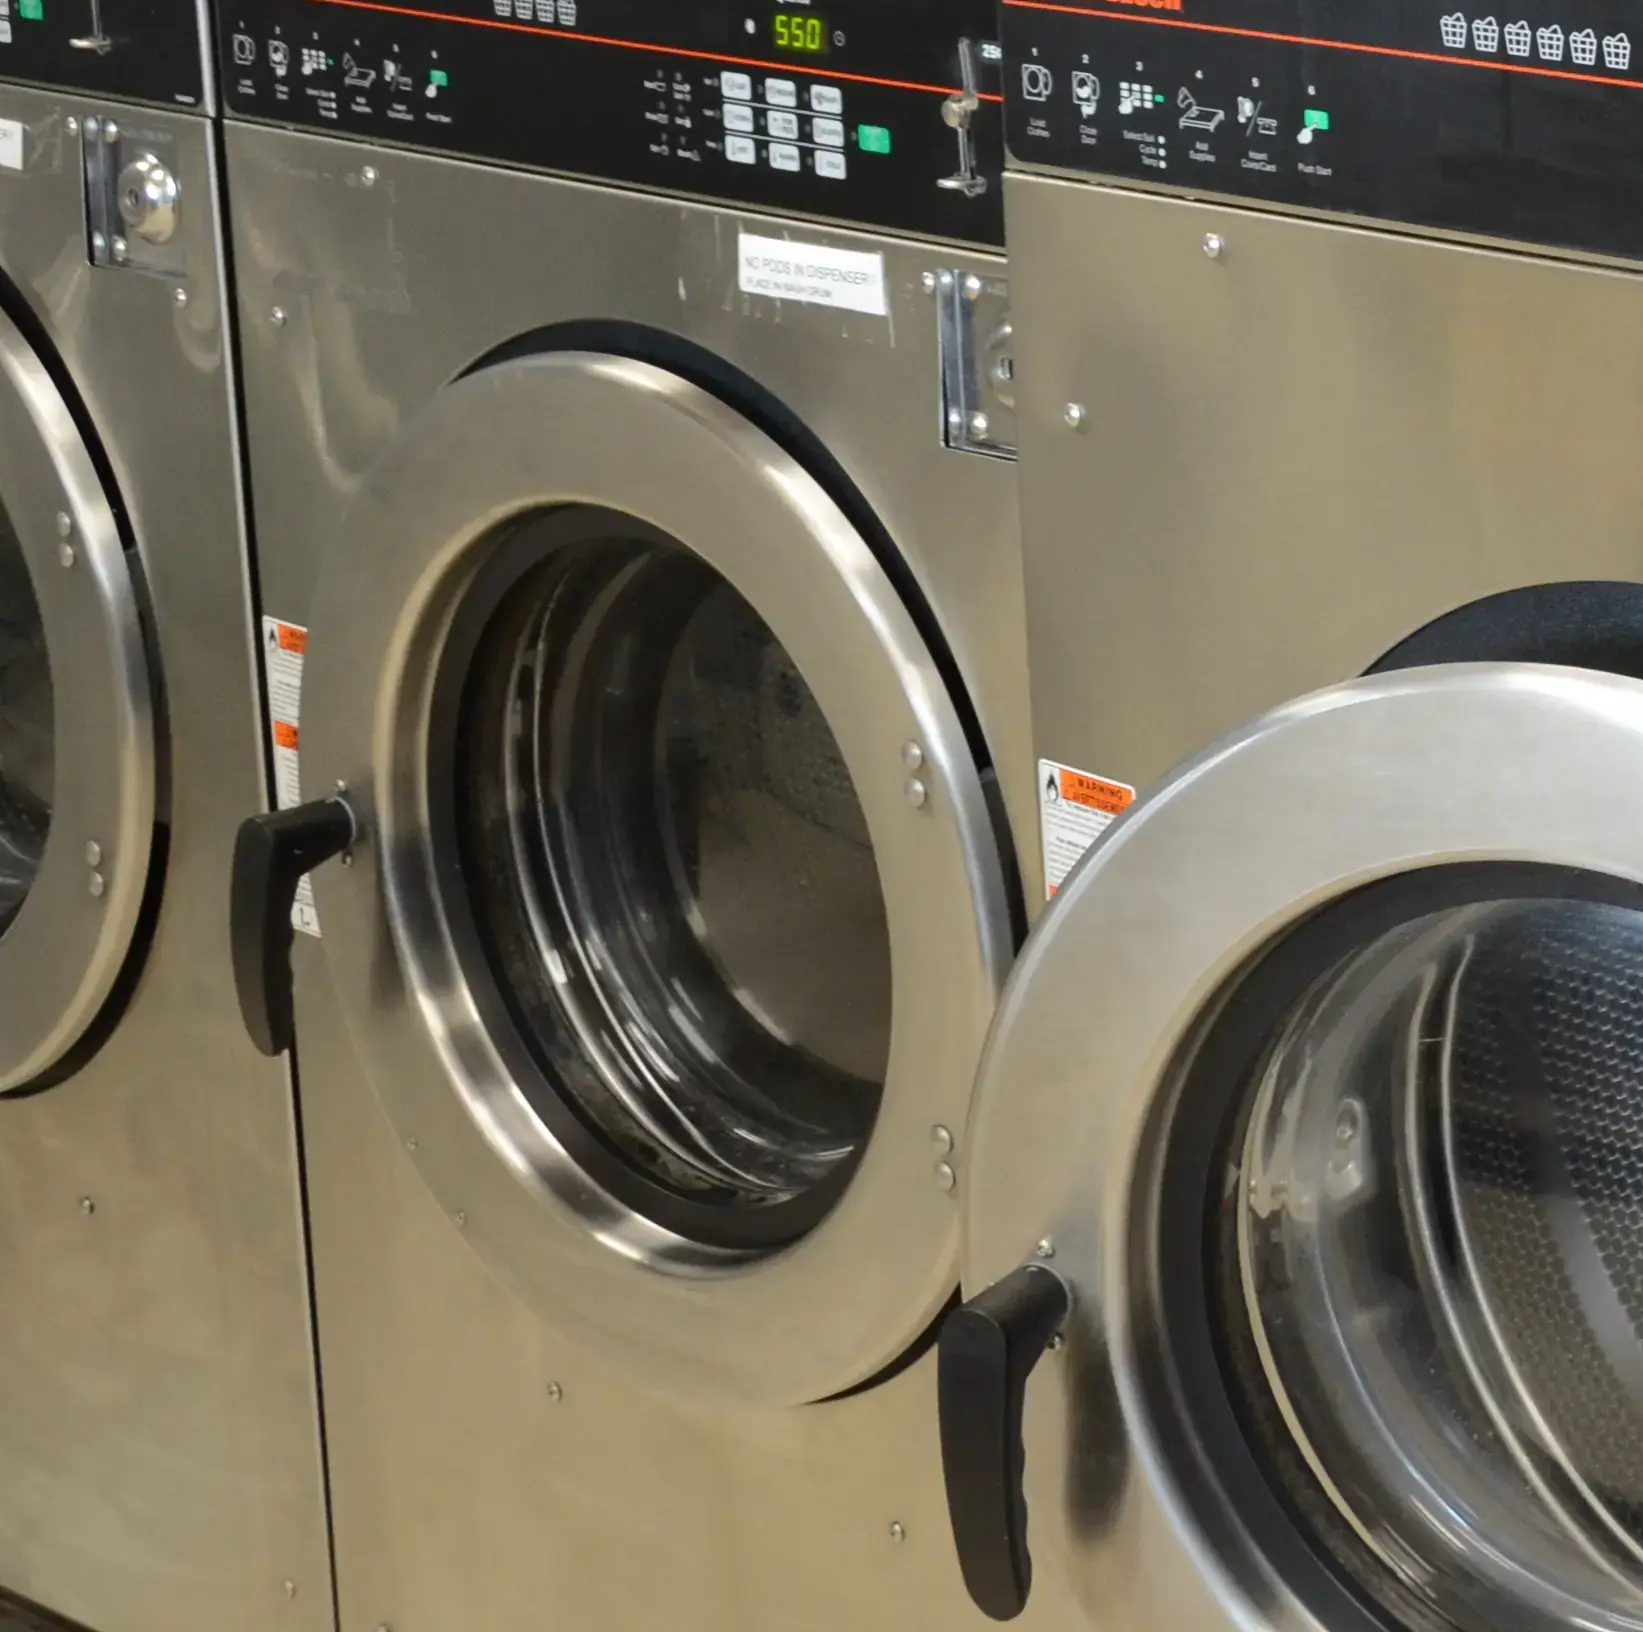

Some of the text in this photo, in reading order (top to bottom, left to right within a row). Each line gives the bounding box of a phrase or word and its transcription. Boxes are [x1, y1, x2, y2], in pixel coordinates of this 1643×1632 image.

[775, 15, 821, 49] 550
[744, 256, 759, 269] NO
[762, 258, 791, 275] PODS
[794, 262, 804, 277] IN
[806, 264, 869, 285] DISPENSER
